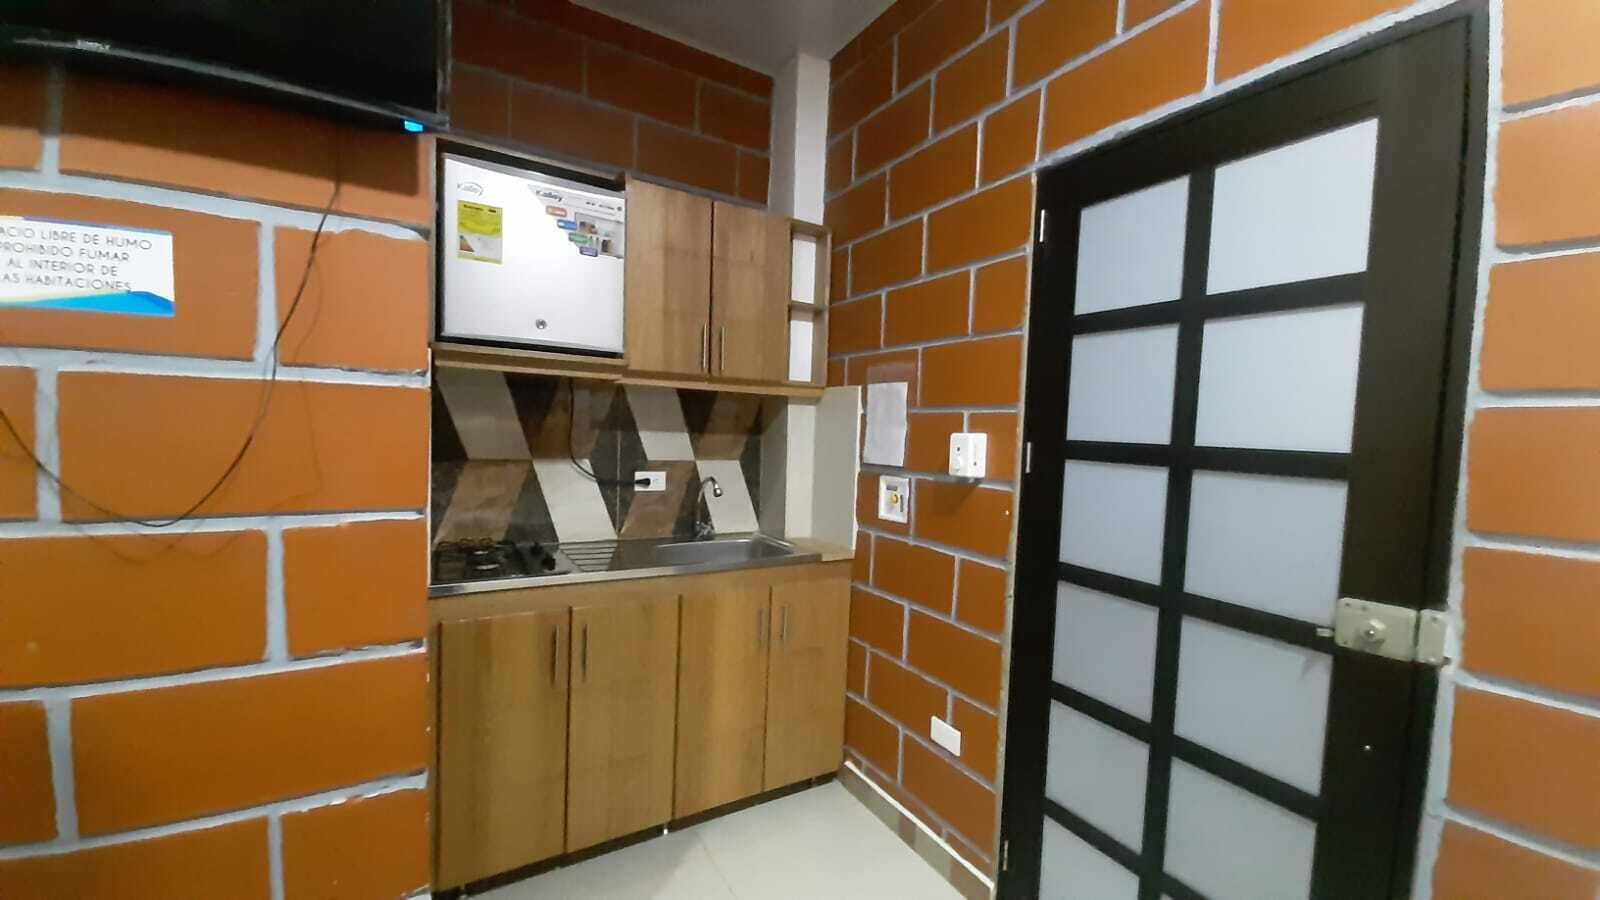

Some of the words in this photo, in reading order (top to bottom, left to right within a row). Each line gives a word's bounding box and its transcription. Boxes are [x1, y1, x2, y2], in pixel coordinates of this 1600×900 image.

[41, 230, 76, 243] LIBRE
[83, 233, 100, 245] DE
[106, 236, 153, 250] HUMO
[79, 248, 130, 262] FUMAR
[8, 257, 23, 269] AL
[30, 259, 94, 274] INTERIOR
[101, 264, 118, 277] DE
[25, 273, 132, 291] HABITACIONES
